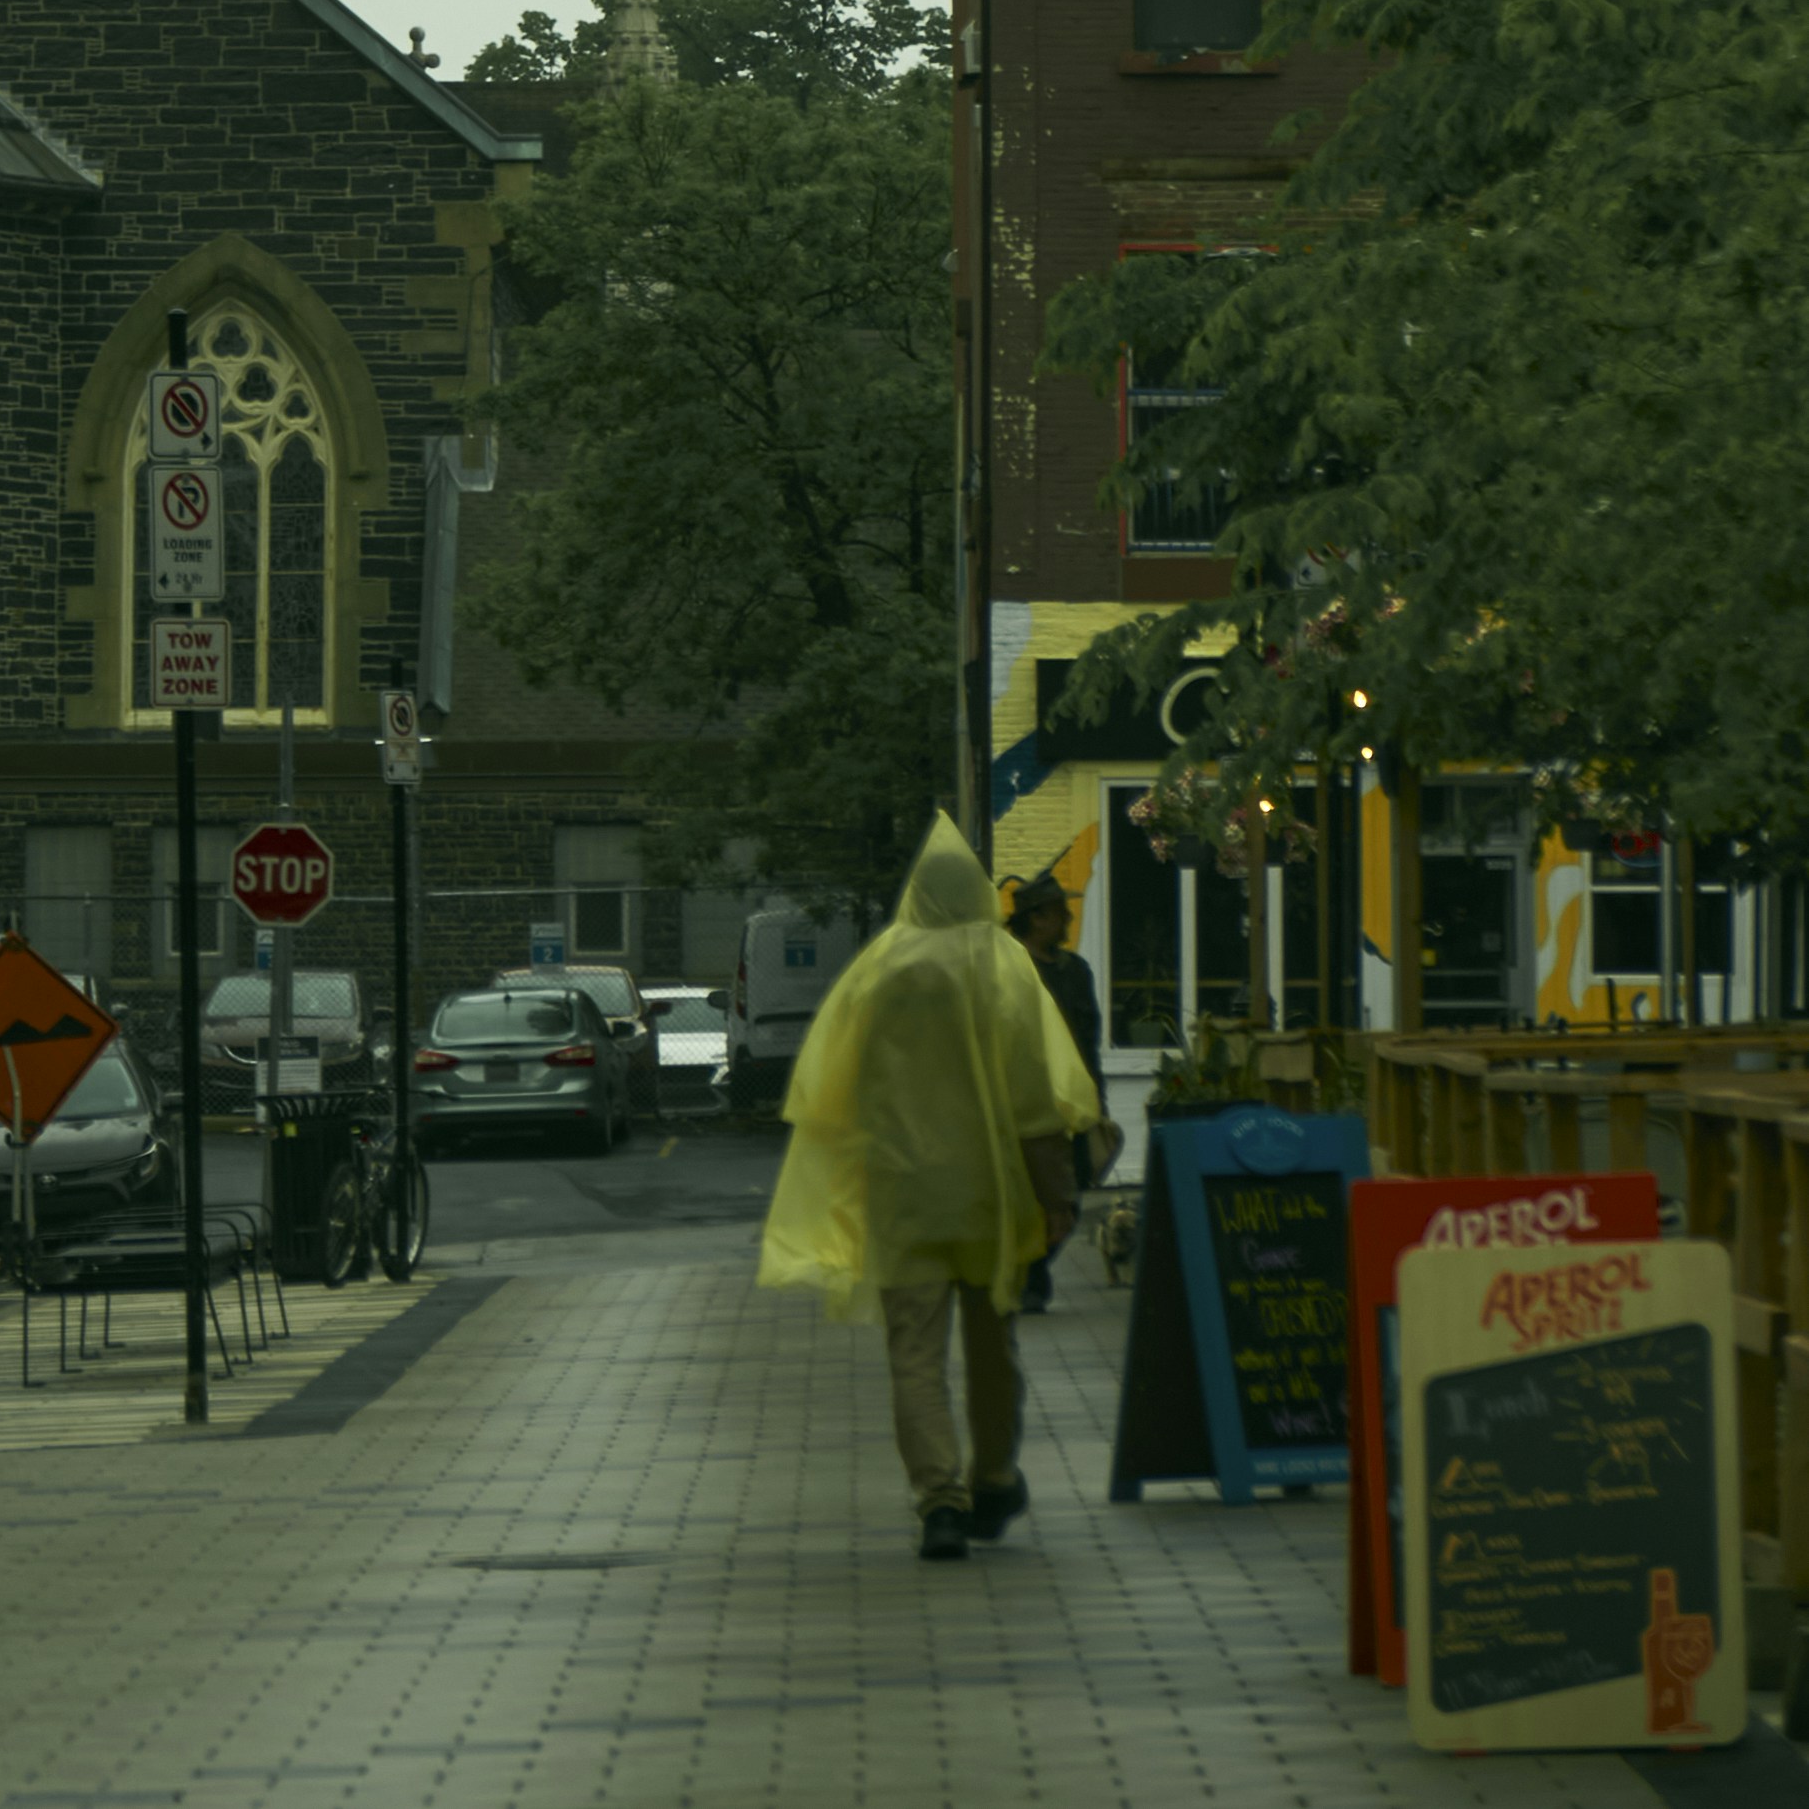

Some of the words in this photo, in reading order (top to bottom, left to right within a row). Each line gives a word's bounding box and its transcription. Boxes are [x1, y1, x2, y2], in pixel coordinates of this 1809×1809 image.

[163, 538, 213, 550] LOADING
[174, 552, 203, 563] ZONE
[167, 633, 213, 649] TOW
[162, 656, 220, 672] AWAY
[163, 679, 218, 695] ZONE
[236, 854, 326, 895] STOP
[542, 946, 554, 964] 2
[1422, 1185, 1601, 1248] APEROL
[1480, 1253, 1652, 1332] APEROL
